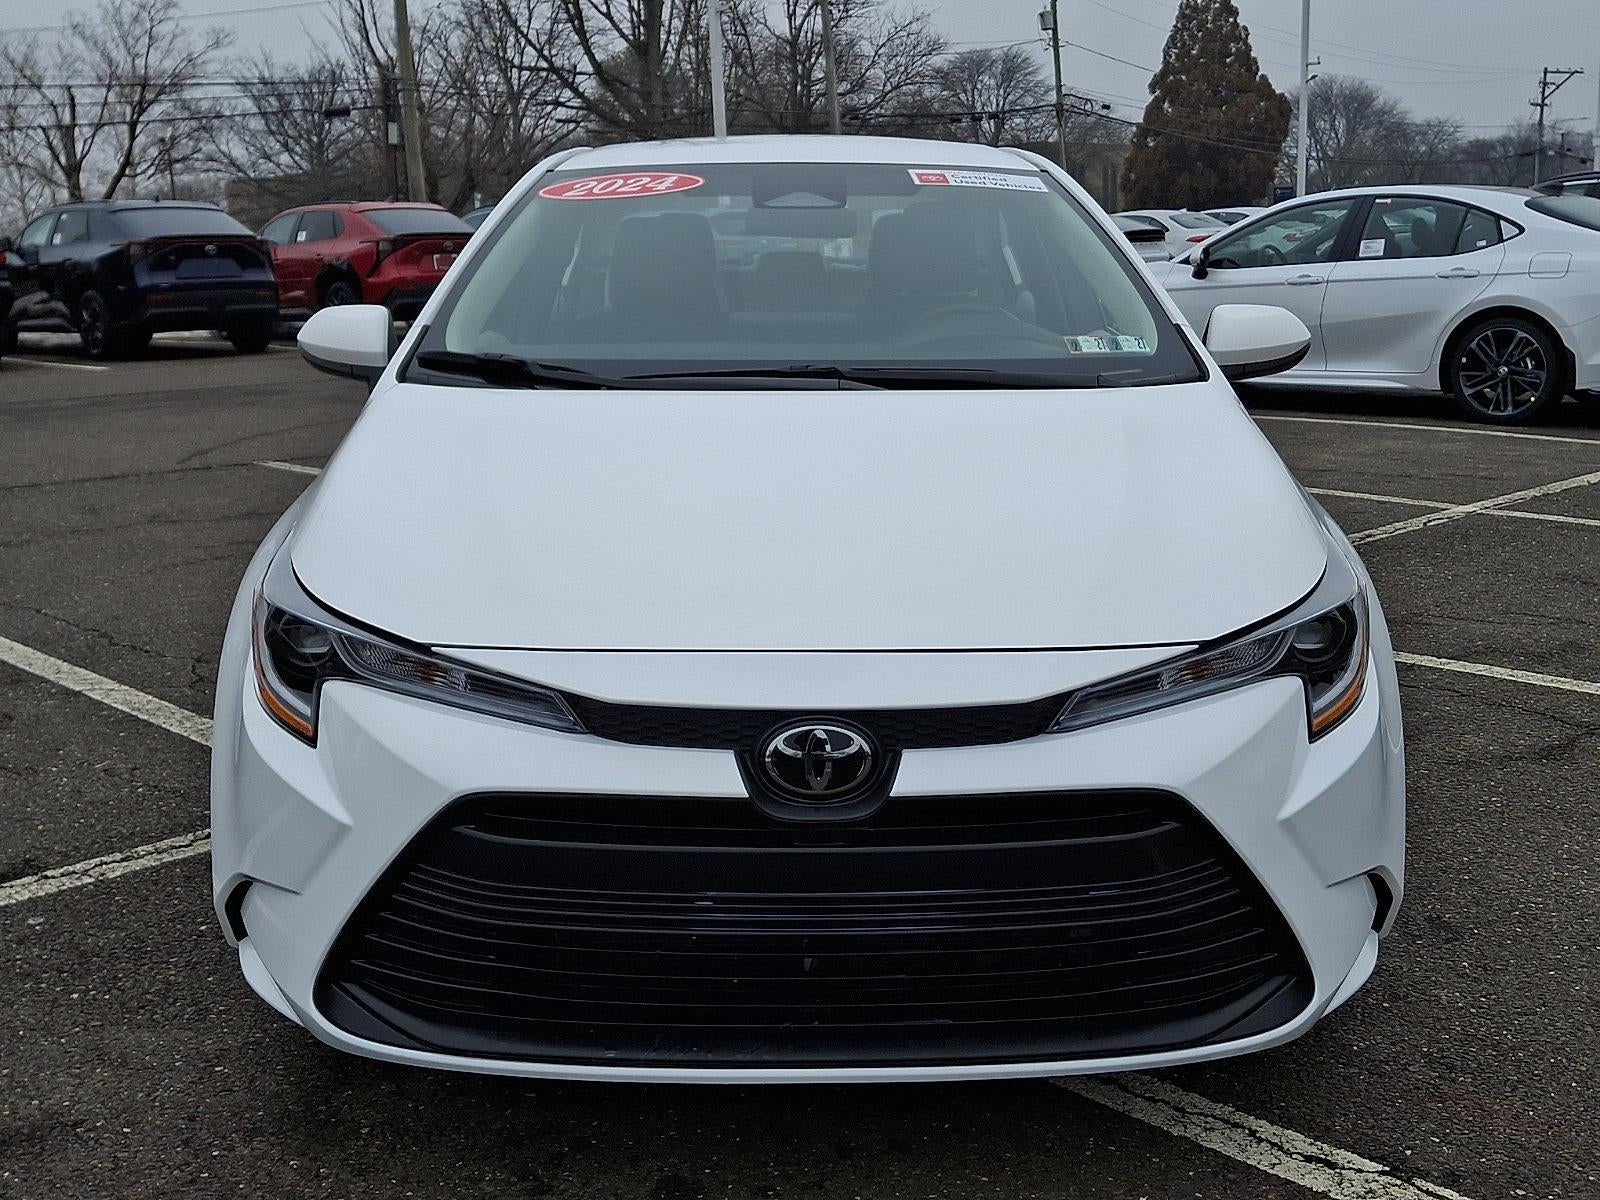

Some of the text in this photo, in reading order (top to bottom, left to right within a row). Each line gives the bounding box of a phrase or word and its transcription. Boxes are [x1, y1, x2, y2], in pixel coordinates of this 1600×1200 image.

[950, 173, 1008, 183] Certified
[953, 178, 1043, 191] Used Vehicles
[562, 175, 679, 197] 2024
[1133, 337, 1147, 350] 27
